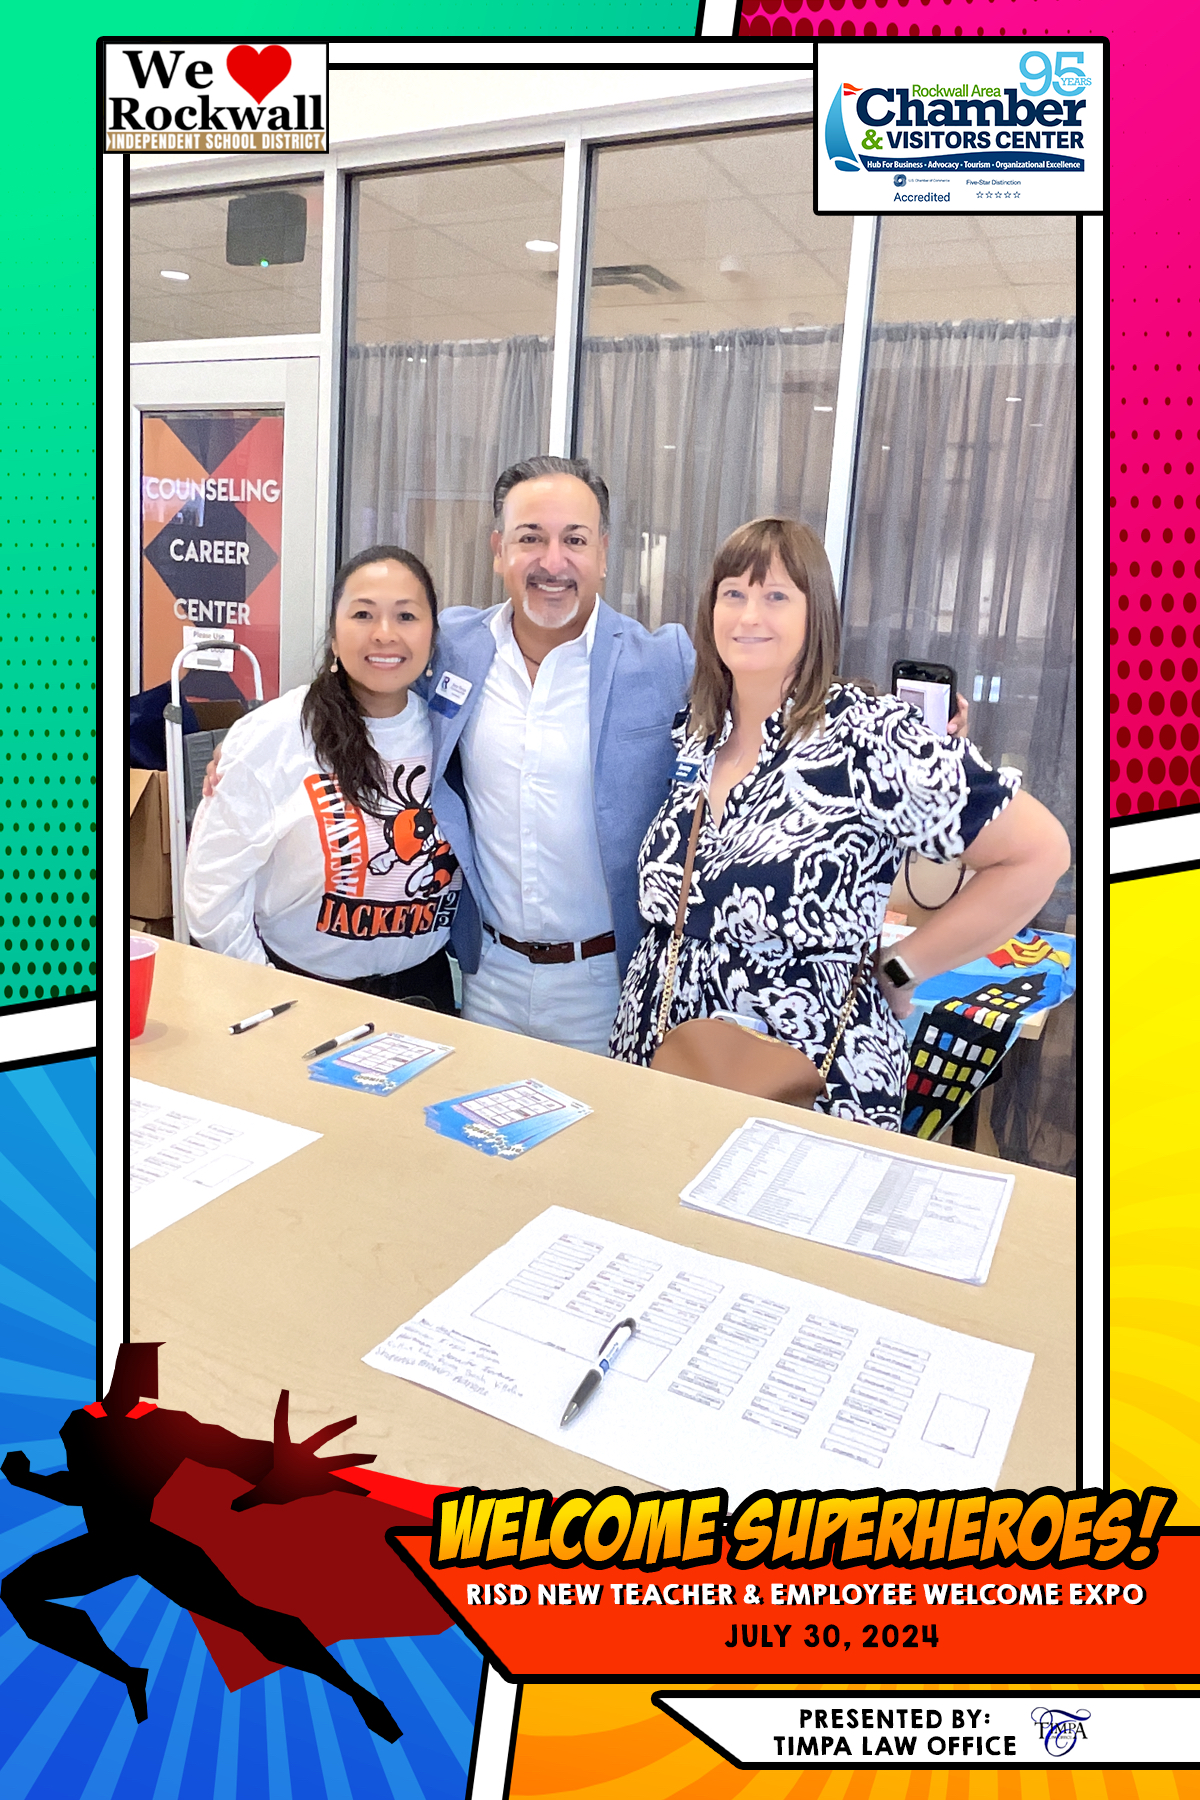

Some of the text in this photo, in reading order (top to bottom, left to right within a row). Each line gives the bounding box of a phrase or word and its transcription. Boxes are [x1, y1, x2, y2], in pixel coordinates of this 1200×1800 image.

[146, 477, 280, 503] COUNSELING
[170, 538, 250, 565] CAREER
[173, 597, 251, 625] CENTER
[317, 897, 437, 936] JACKETS
